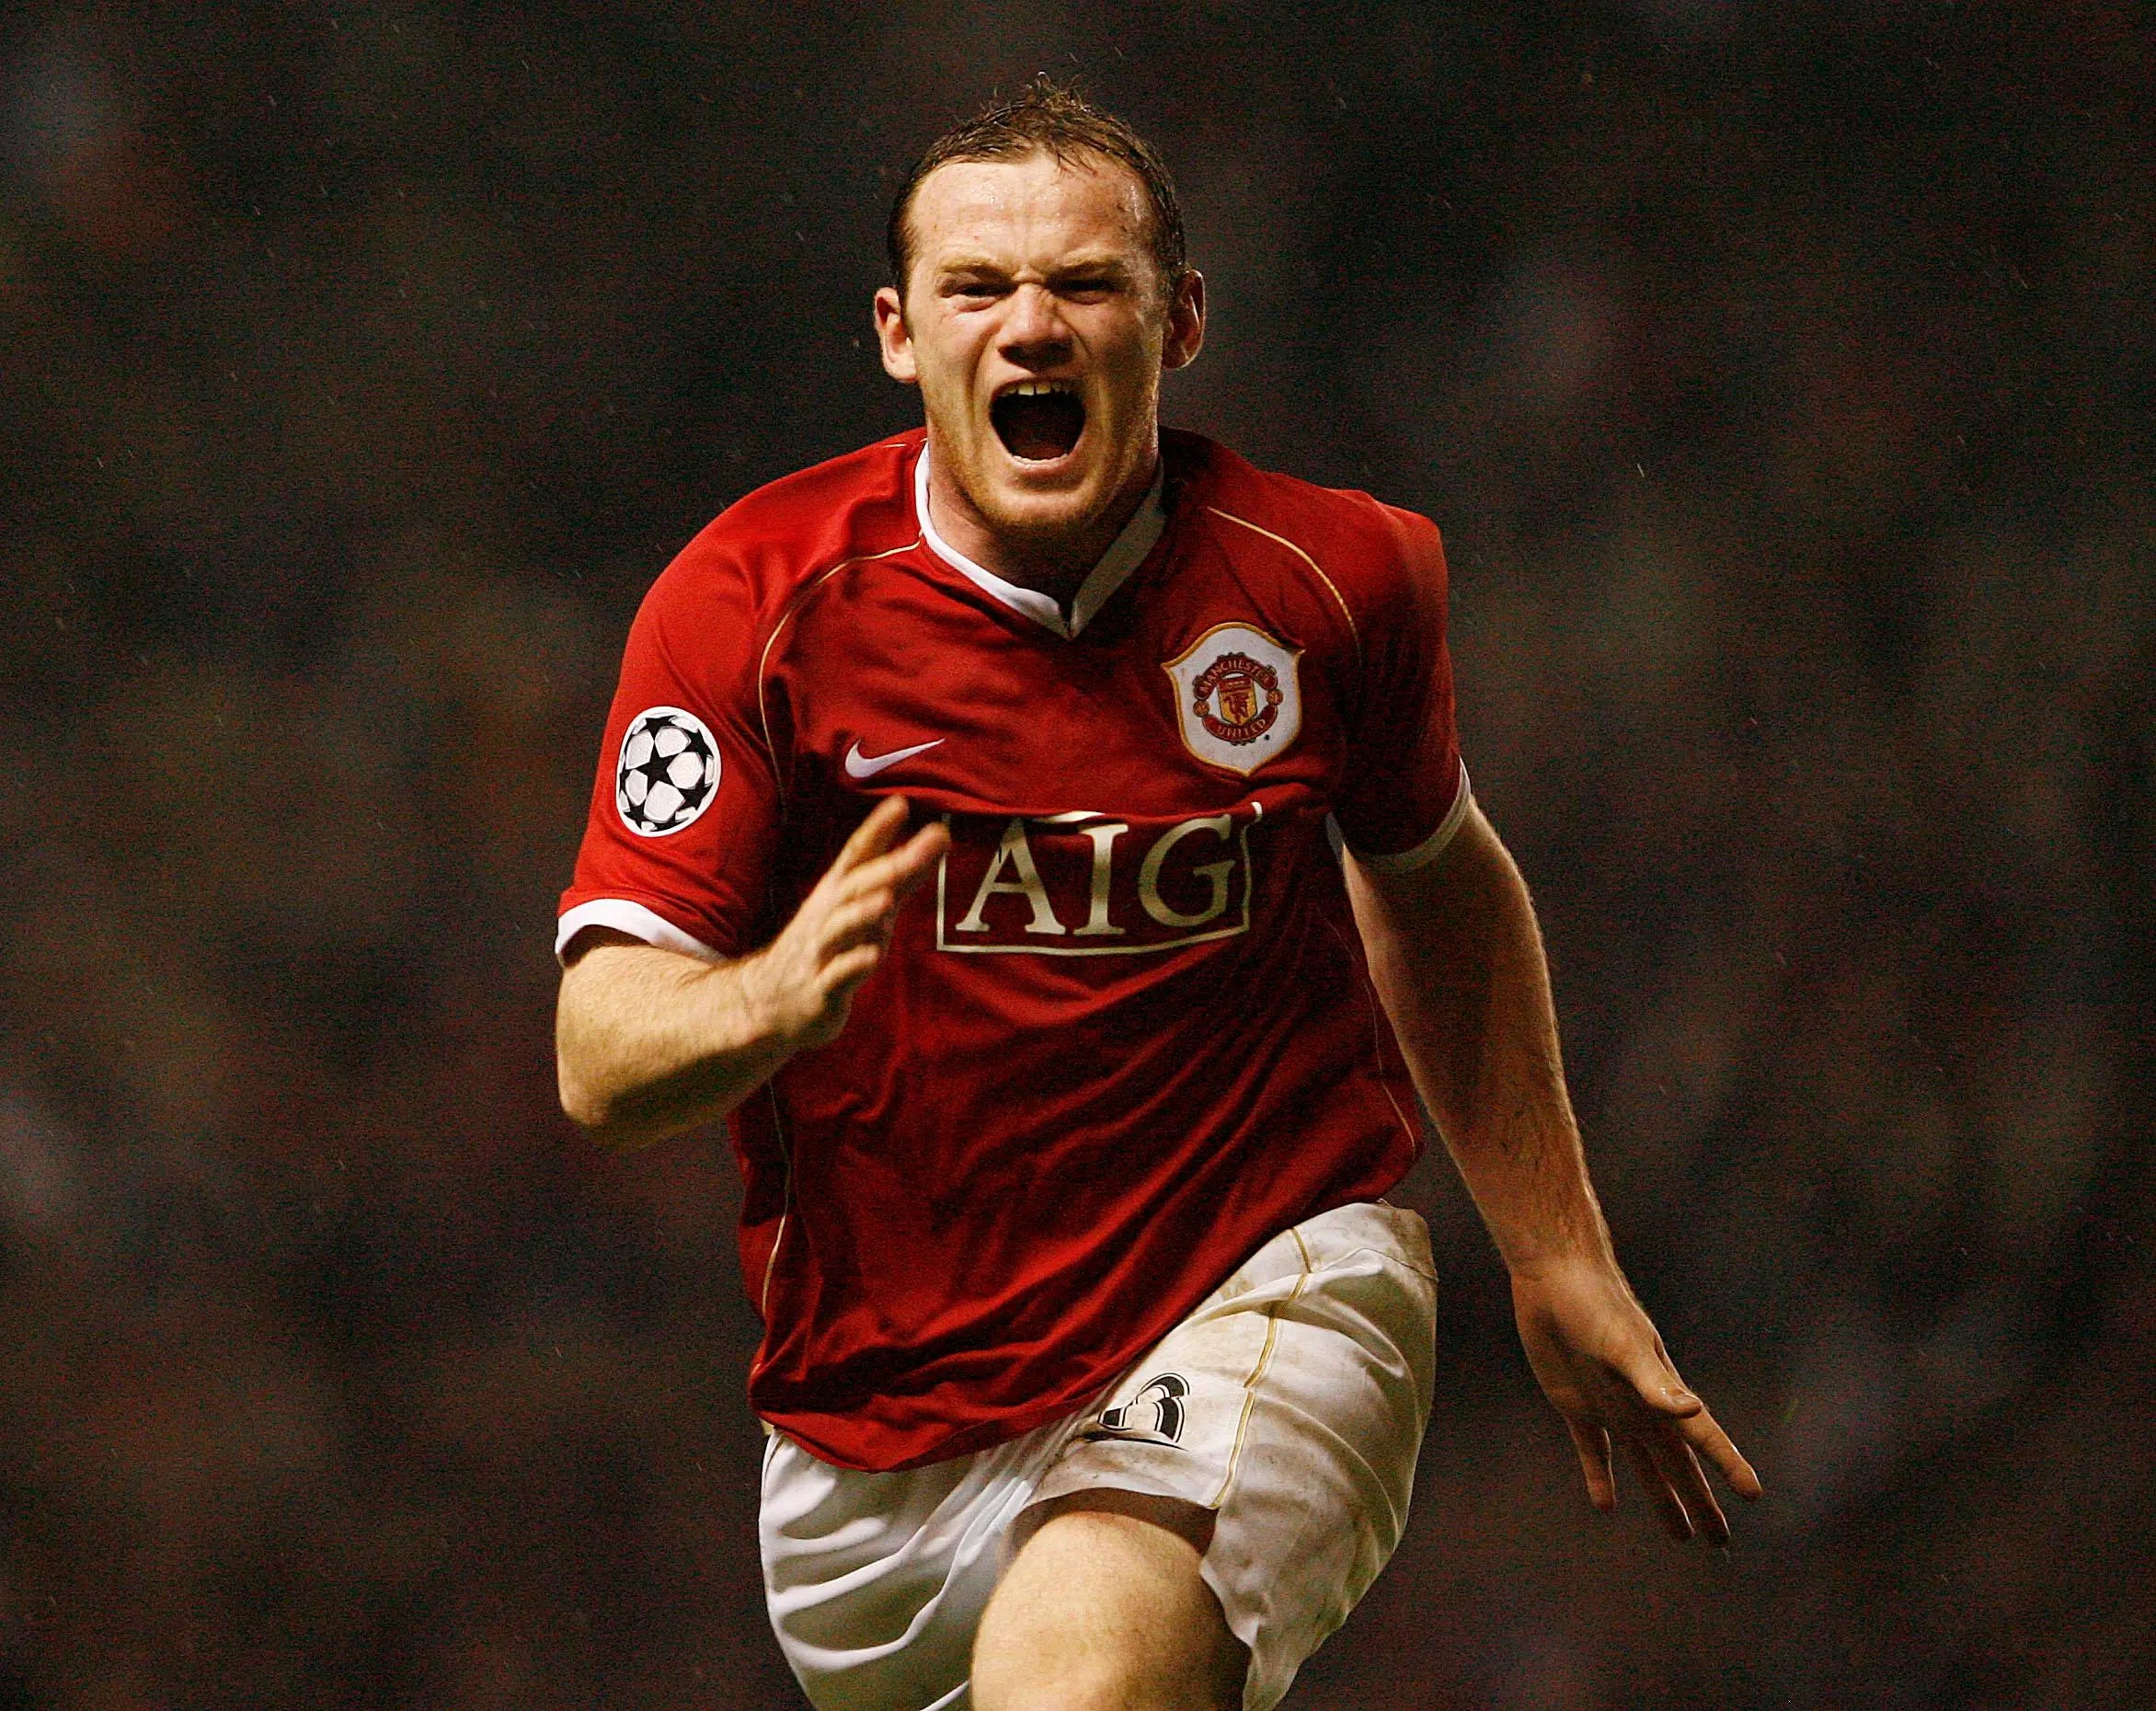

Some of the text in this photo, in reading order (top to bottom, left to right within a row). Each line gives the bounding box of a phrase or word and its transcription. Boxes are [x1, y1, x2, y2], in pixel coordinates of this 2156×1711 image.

[1198, 658, 1272, 694] MANCHESTER
[1217, 718, 1267, 739] UNITED
[955, 814, 1235, 936] AIG
